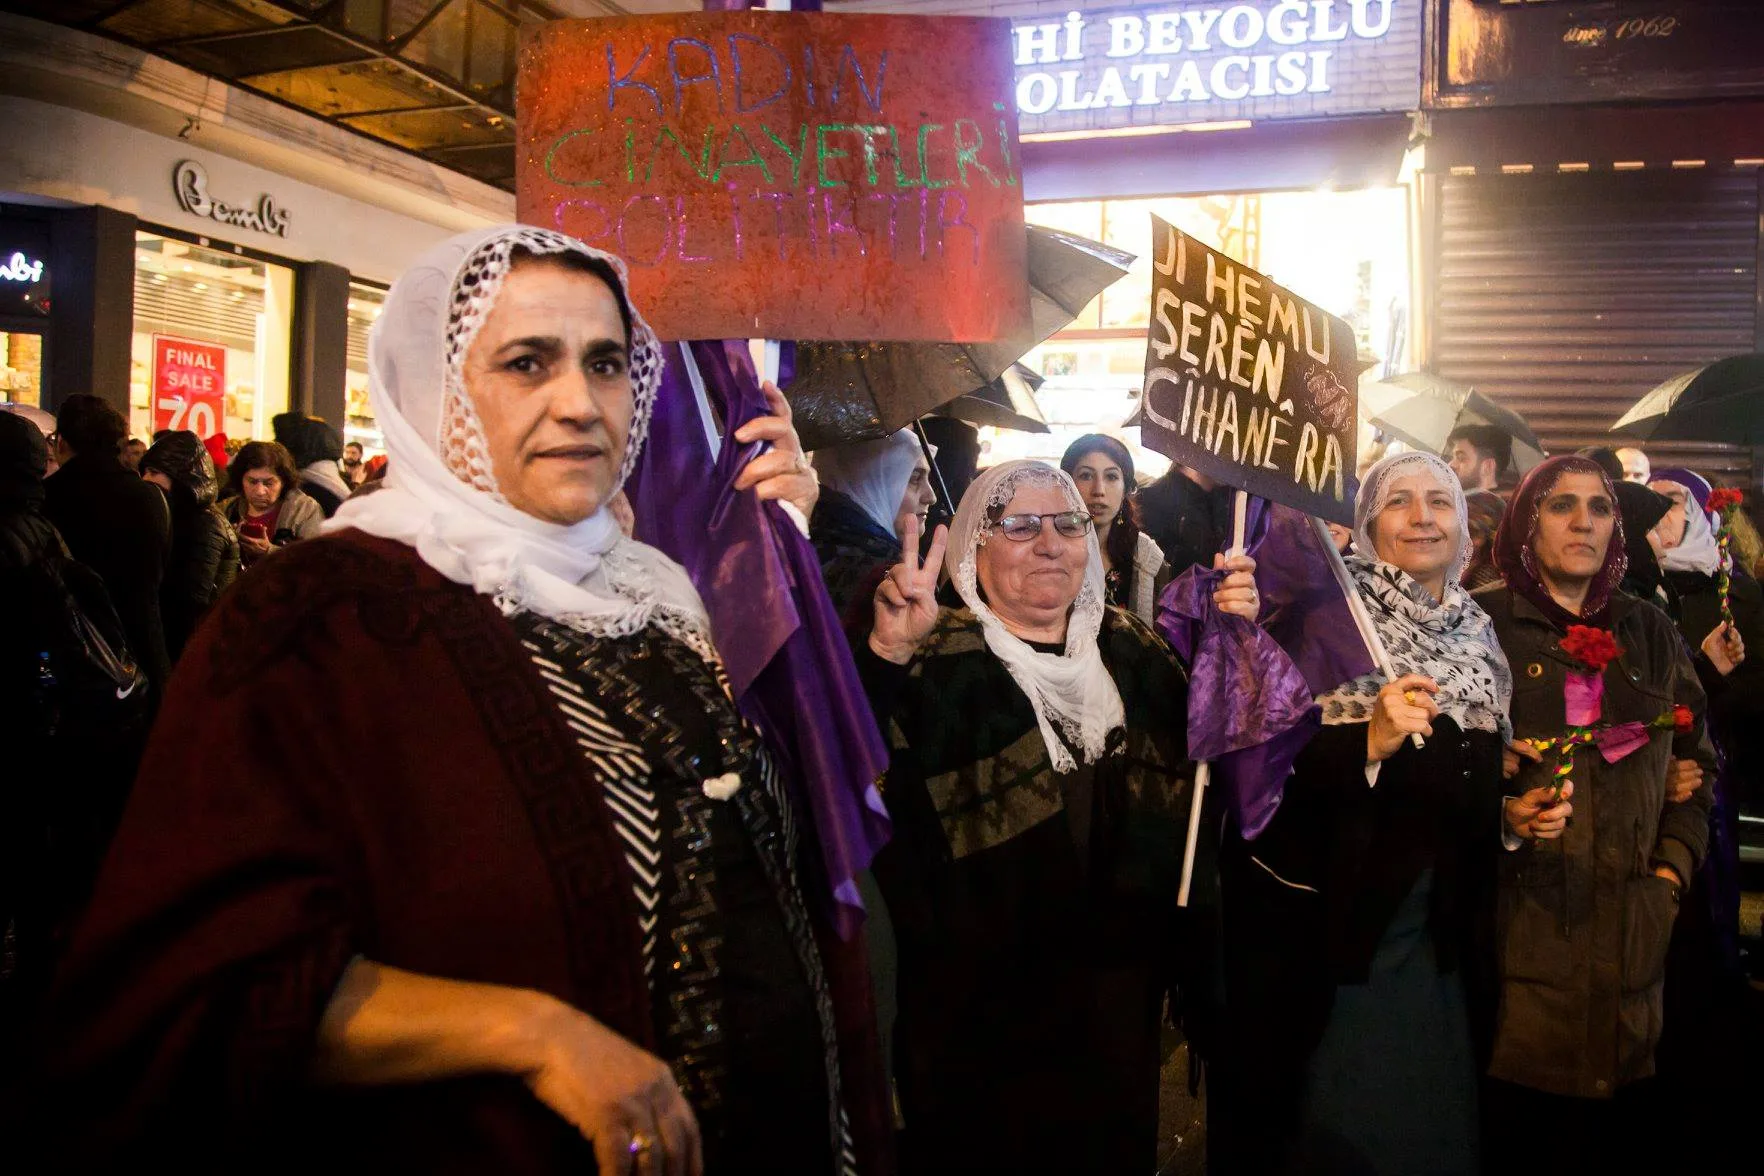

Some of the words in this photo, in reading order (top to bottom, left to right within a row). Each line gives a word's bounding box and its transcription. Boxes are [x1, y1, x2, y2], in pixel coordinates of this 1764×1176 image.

[1615, 16, 1676, 39] 1962
[605, 31, 889, 115] KADIN
[1016, 51, 1332, 114] OLATACISI
[166, 348, 217, 370] FINAL
[167, 371, 213, 392] SALE
[1294, 421, 1344, 502] RA
